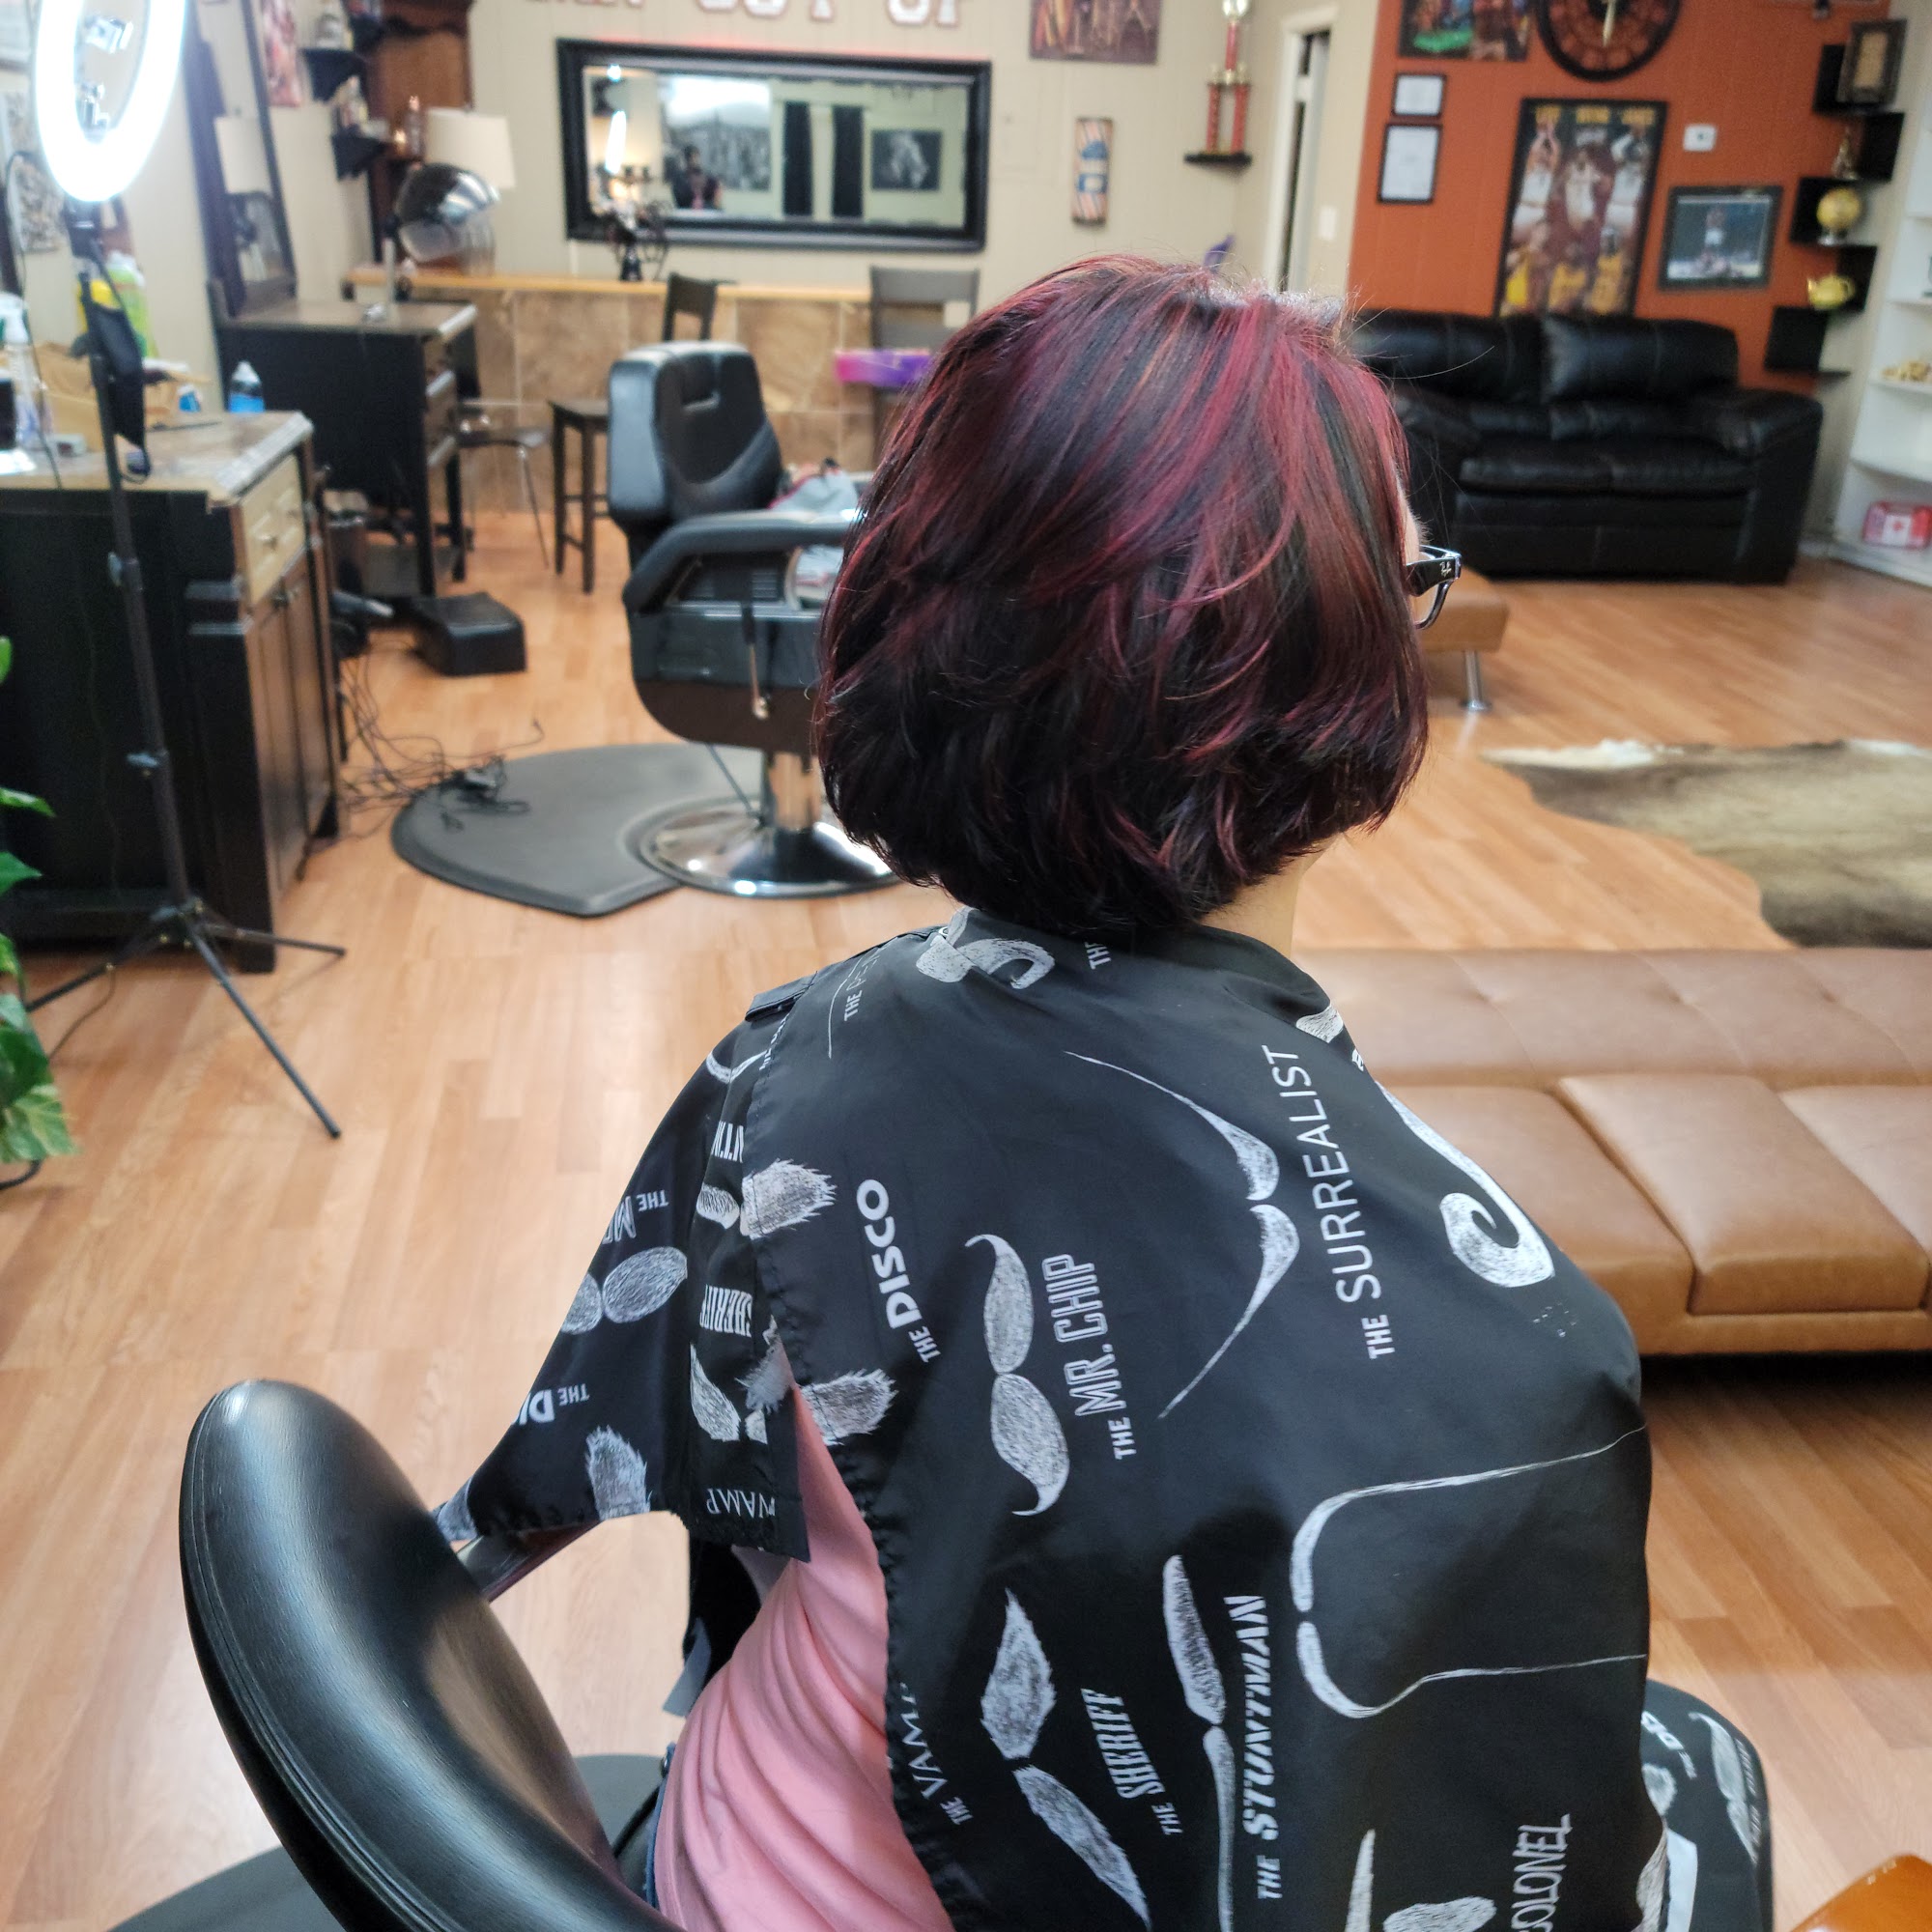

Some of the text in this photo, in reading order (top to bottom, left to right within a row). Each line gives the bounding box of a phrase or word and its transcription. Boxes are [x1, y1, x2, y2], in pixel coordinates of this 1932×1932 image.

[843, 990, 863, 1022] THE
[637, 1189, 669, 1212] THE
[856, 1179, 941, 1363] THE DISCO
[1262, 1044, 1395, 1360] THE SURREALIST
[557, 1383, 590, 1406] THE
[1041, 1254, 1137, 1460] THE MR. CHIP
[940, 1796, 974, 1826] THE
[1080, 1688, 1184, 1835] THE SHERIFF
[1223, 1595, 1283, 1899] THE STUNTMAN
